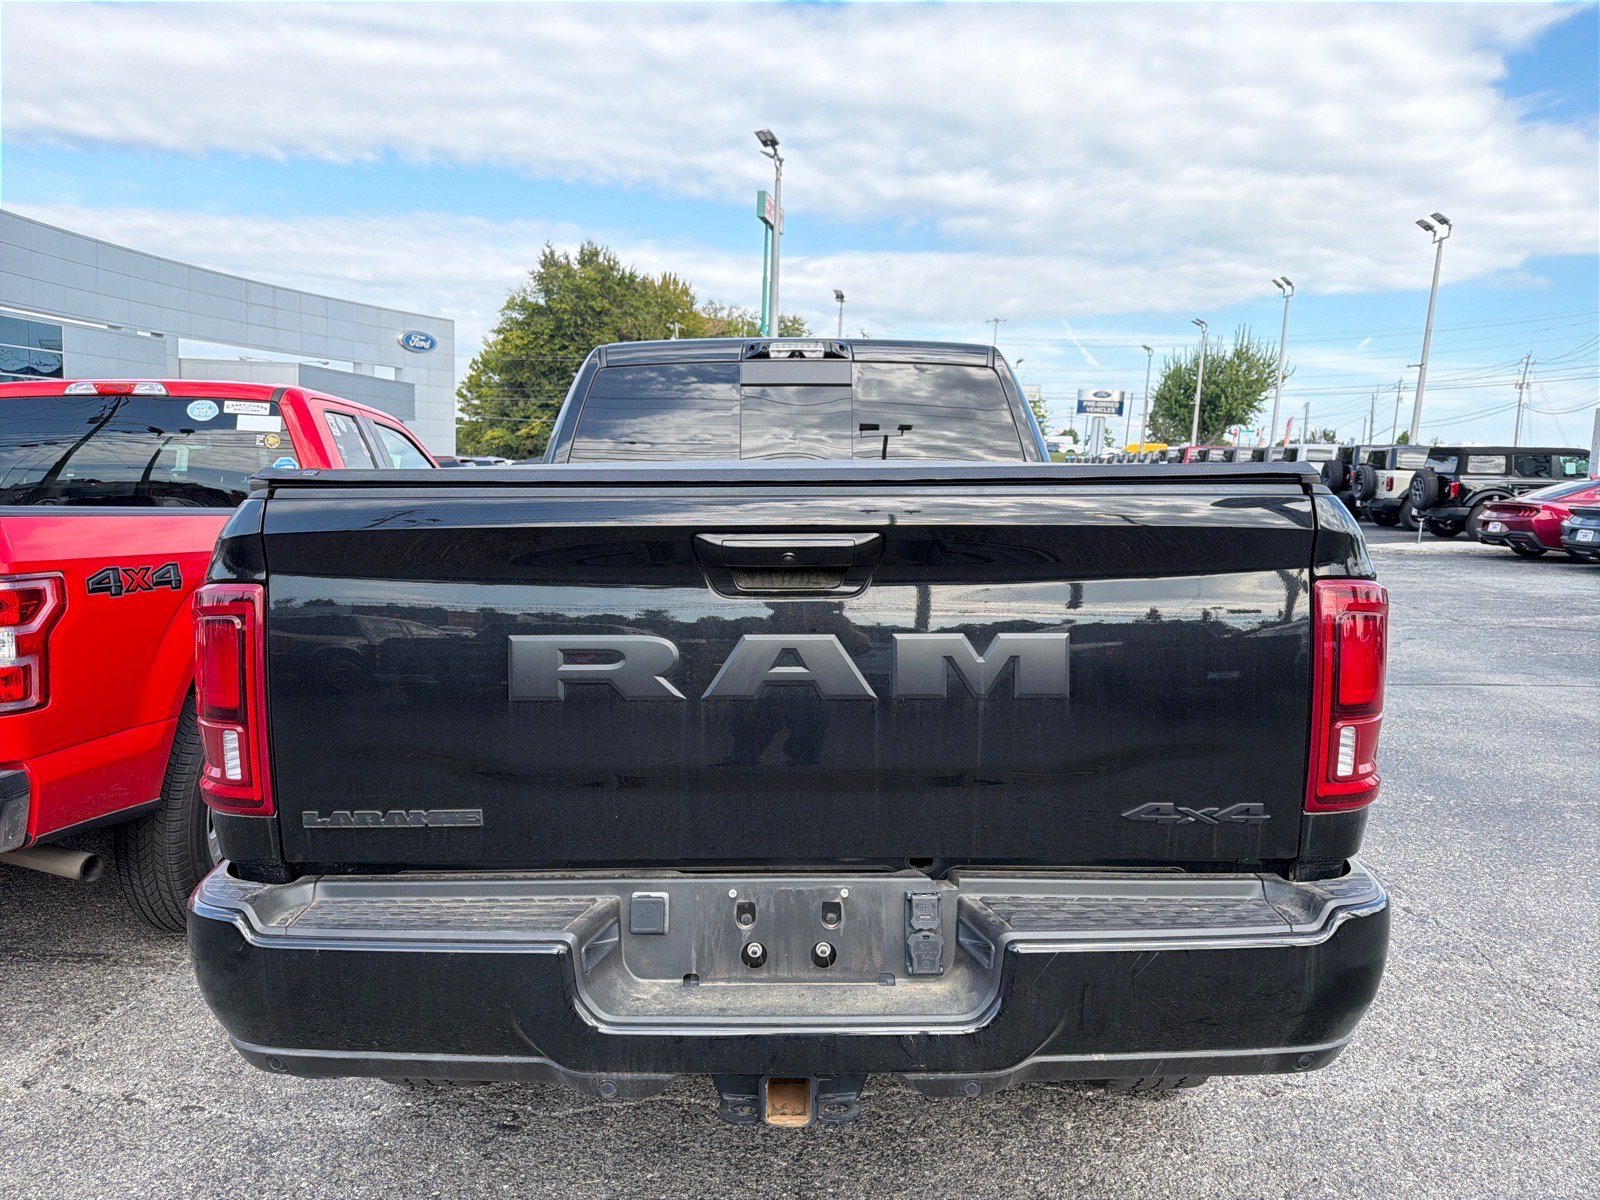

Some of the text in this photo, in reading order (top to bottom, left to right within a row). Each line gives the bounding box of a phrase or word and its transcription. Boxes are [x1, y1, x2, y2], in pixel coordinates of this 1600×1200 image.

[409, 334, 432, 348] Ford
[508, 633, 1071, 700] RAM
[302, 809, 484, 828] LARAMIE
